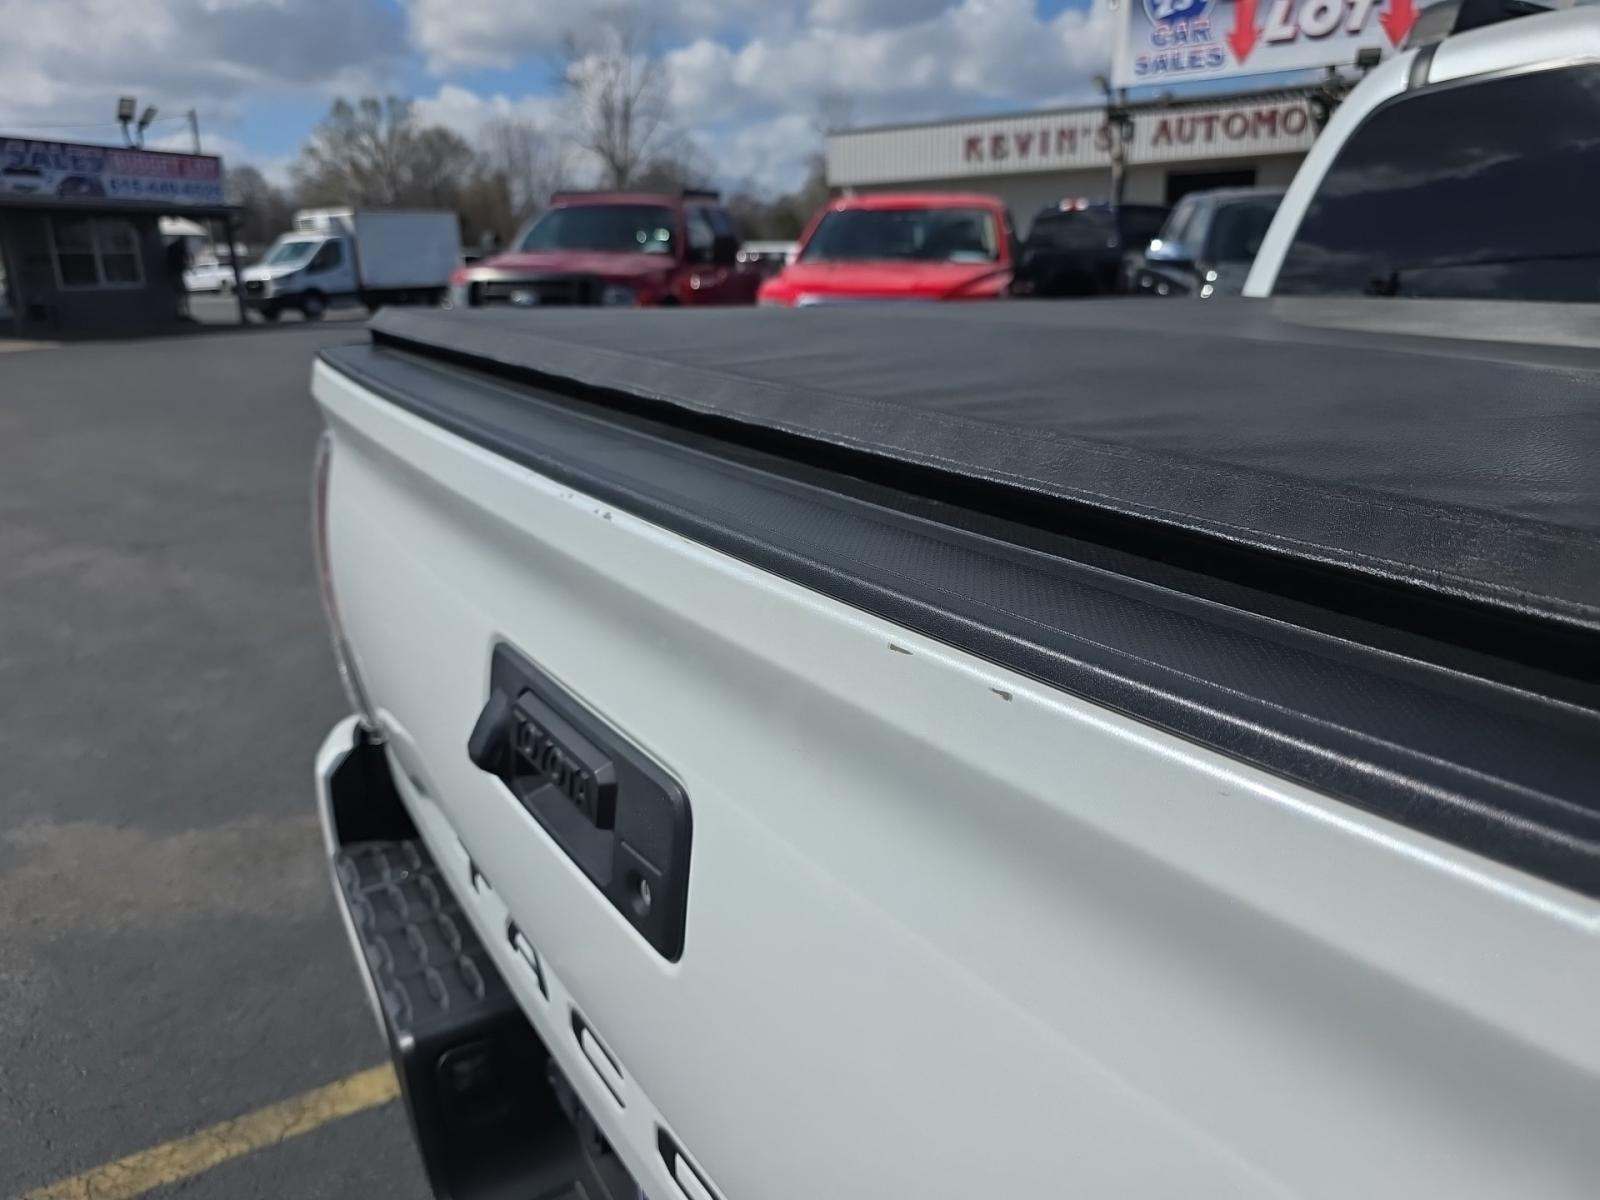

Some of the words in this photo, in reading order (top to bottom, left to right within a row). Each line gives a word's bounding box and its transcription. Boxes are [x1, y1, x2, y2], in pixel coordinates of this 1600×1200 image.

[1151, 19, 1211, 46] CAR
[1135, 46, 1224, 76] SALES
[964, 124, 1113, 162] KEVIN'S
[1152, 107, 1308, 147] AUTOMO
